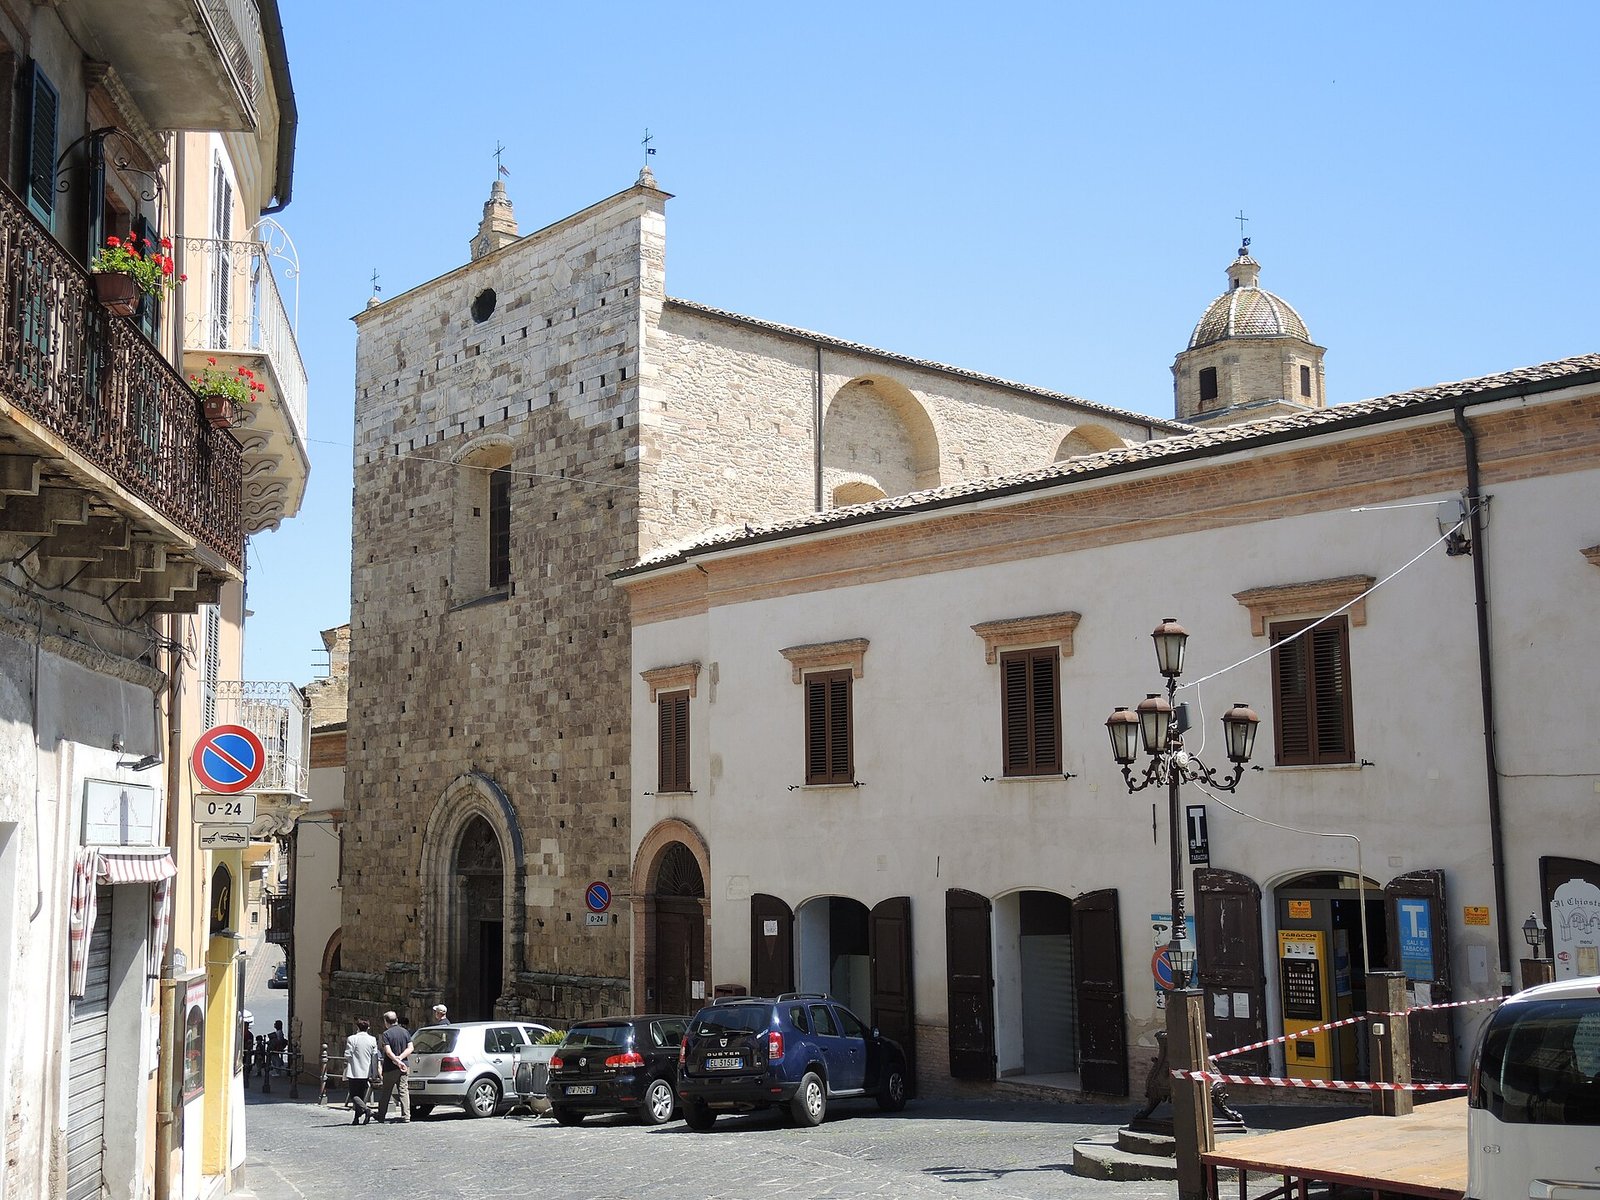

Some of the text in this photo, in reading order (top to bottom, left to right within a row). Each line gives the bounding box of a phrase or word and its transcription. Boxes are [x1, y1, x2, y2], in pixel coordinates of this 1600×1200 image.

[208, 802, 241, 816] 0-24
[1190, 808, 1203, 847] T
[1566, 897, 1600, 908] Chiost
[590, 915, 604, 923] 0-24
[1402, 905, 1424, 938] T
[1403, 945, 1429, 953] TABACCHI
